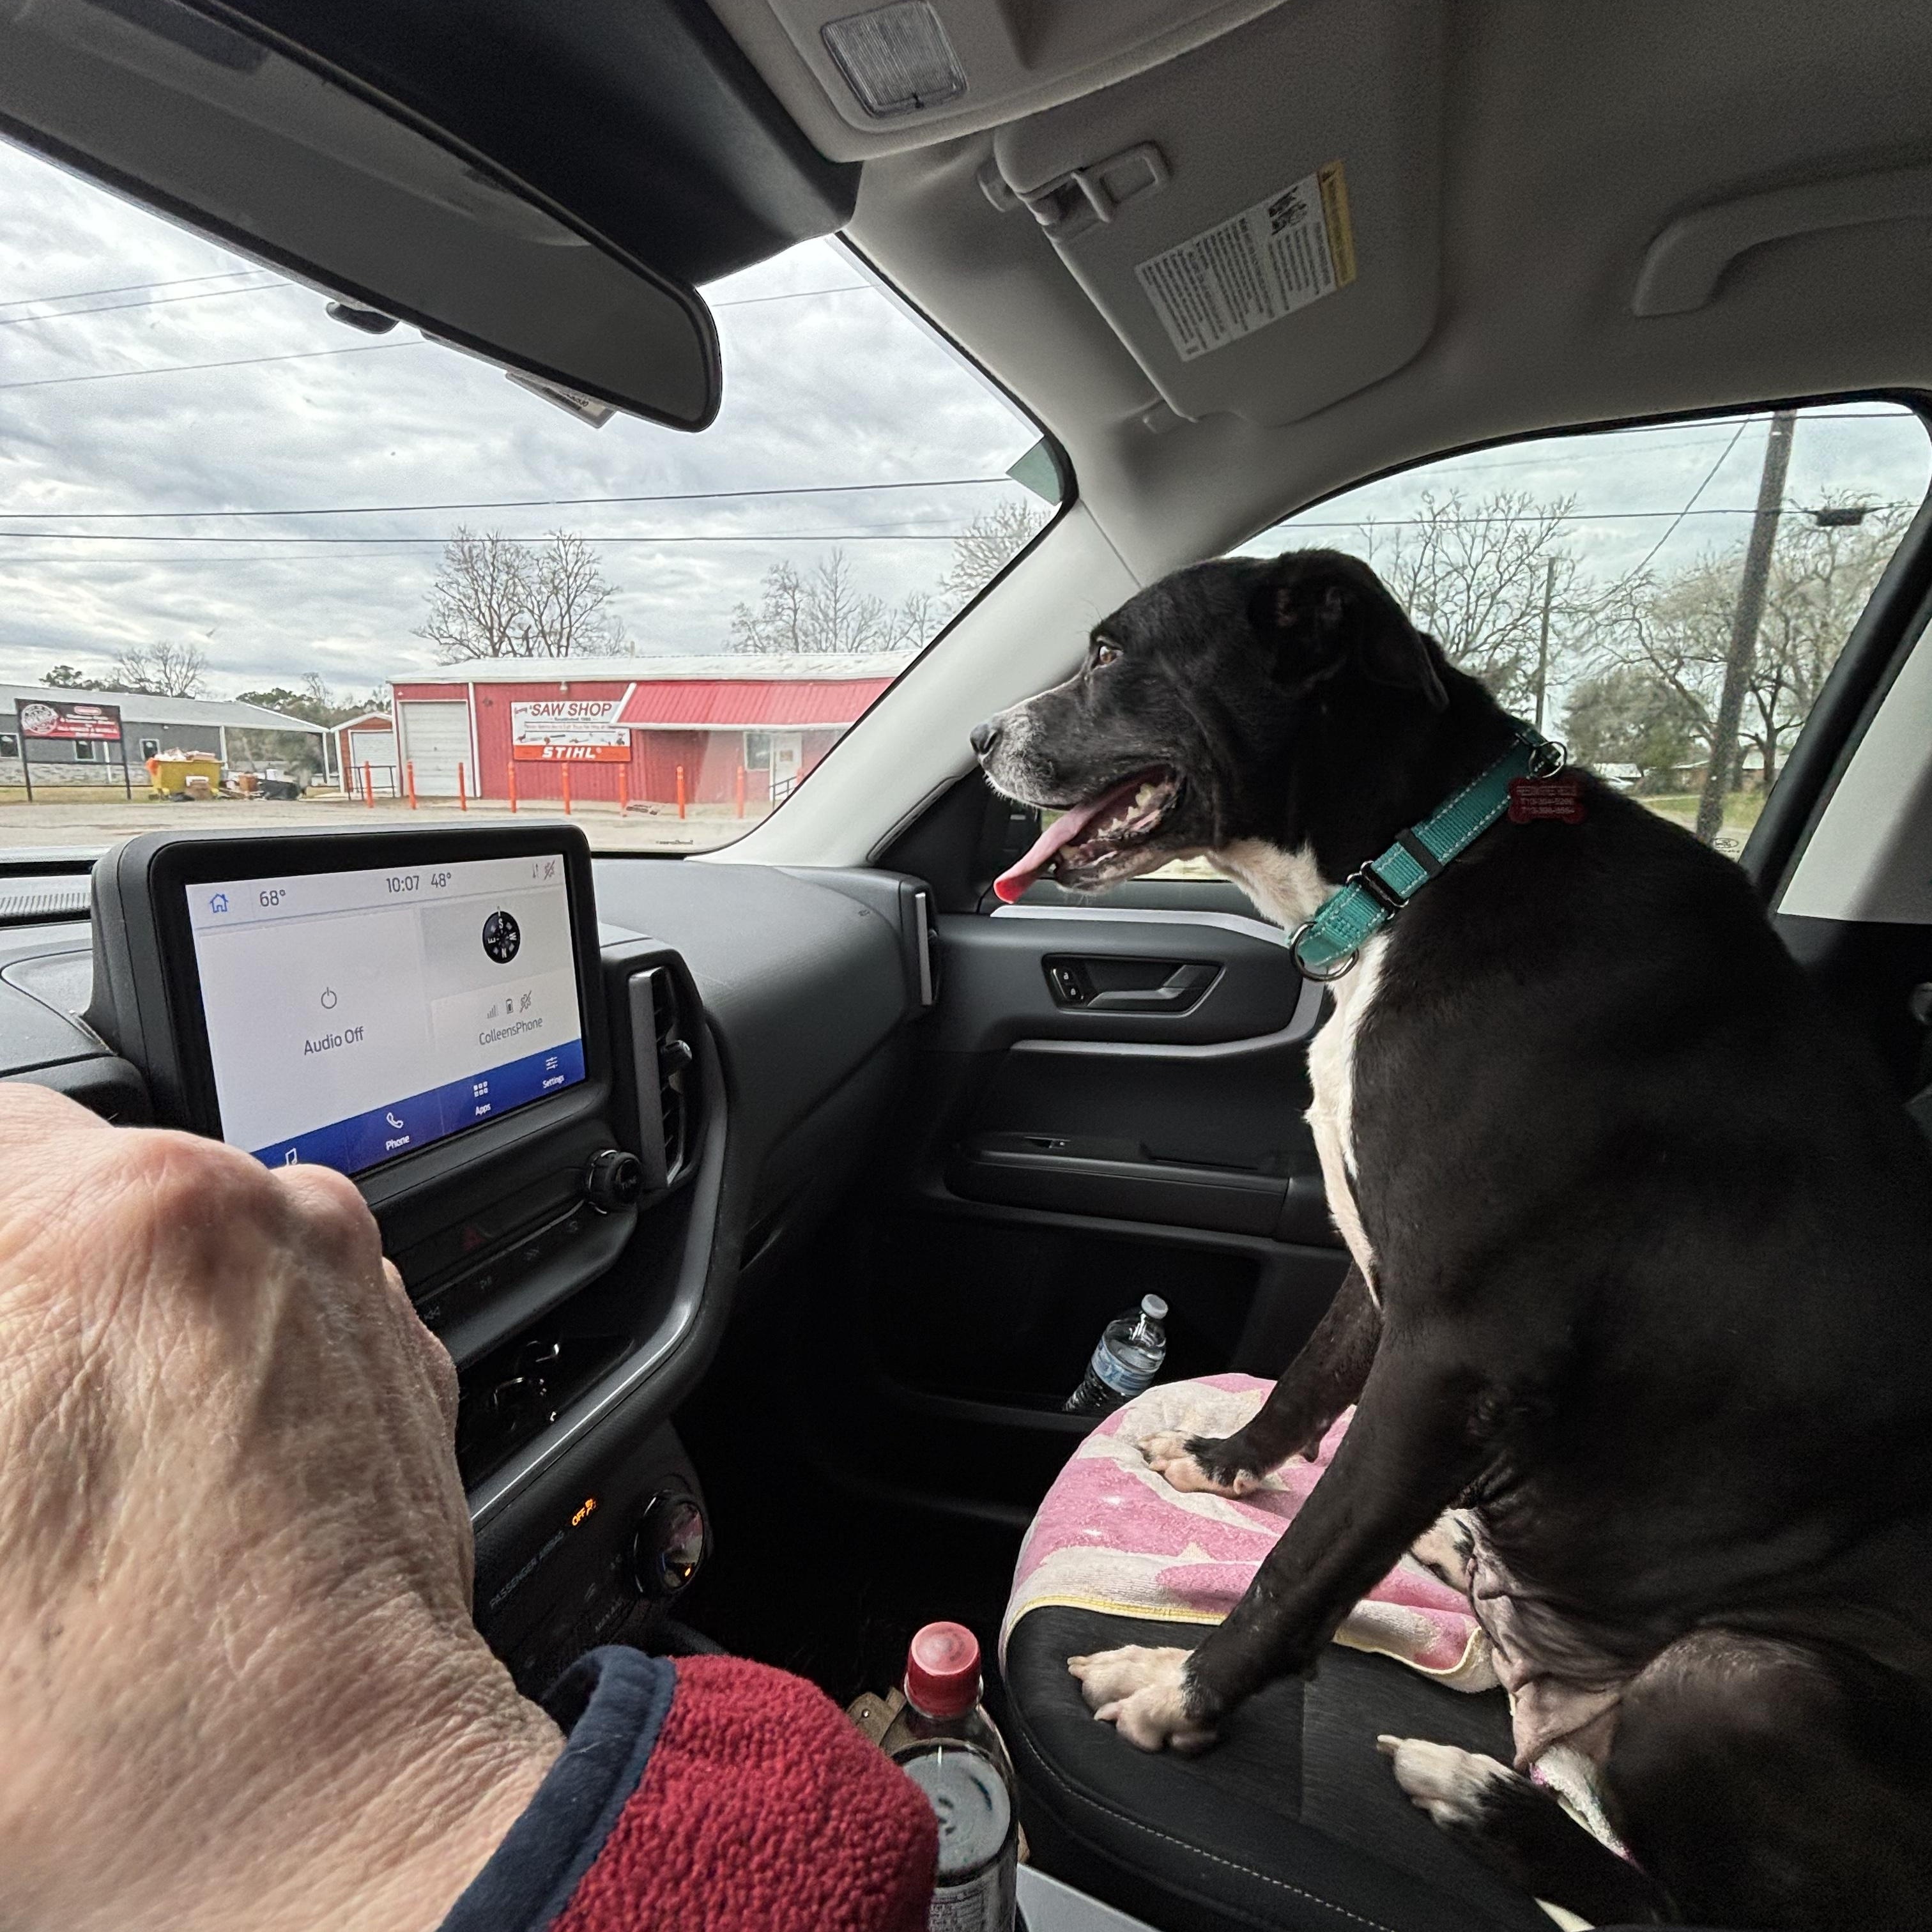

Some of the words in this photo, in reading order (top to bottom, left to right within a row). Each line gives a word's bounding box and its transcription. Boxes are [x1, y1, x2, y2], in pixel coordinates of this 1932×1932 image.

[531, 703, 565, 716] SAW
[567, 703, 612, 716] SHOP
[542, 746, 596, 759] STIHL
[386, 875, 419, 893] 10:07
[431, 872, 451, 888] 48°
[260, 889, 286, 907] 68°
[498, 918, 503, 929] S
[509, 932, 518, 940] W
[502, 948, 507, 958] N
[479, 1018, 543, 1045] ColleensPhone
[304, 1034, 342, 1055] Audio
[345, 1026, 364, 1044] Off
[542, 1075, 565, 1089] Settings
[475, 1103, 491, 1116] Apps
[386, 1135, 410, 1151] Phone
[572, 1506, 586, 1526] OFF
